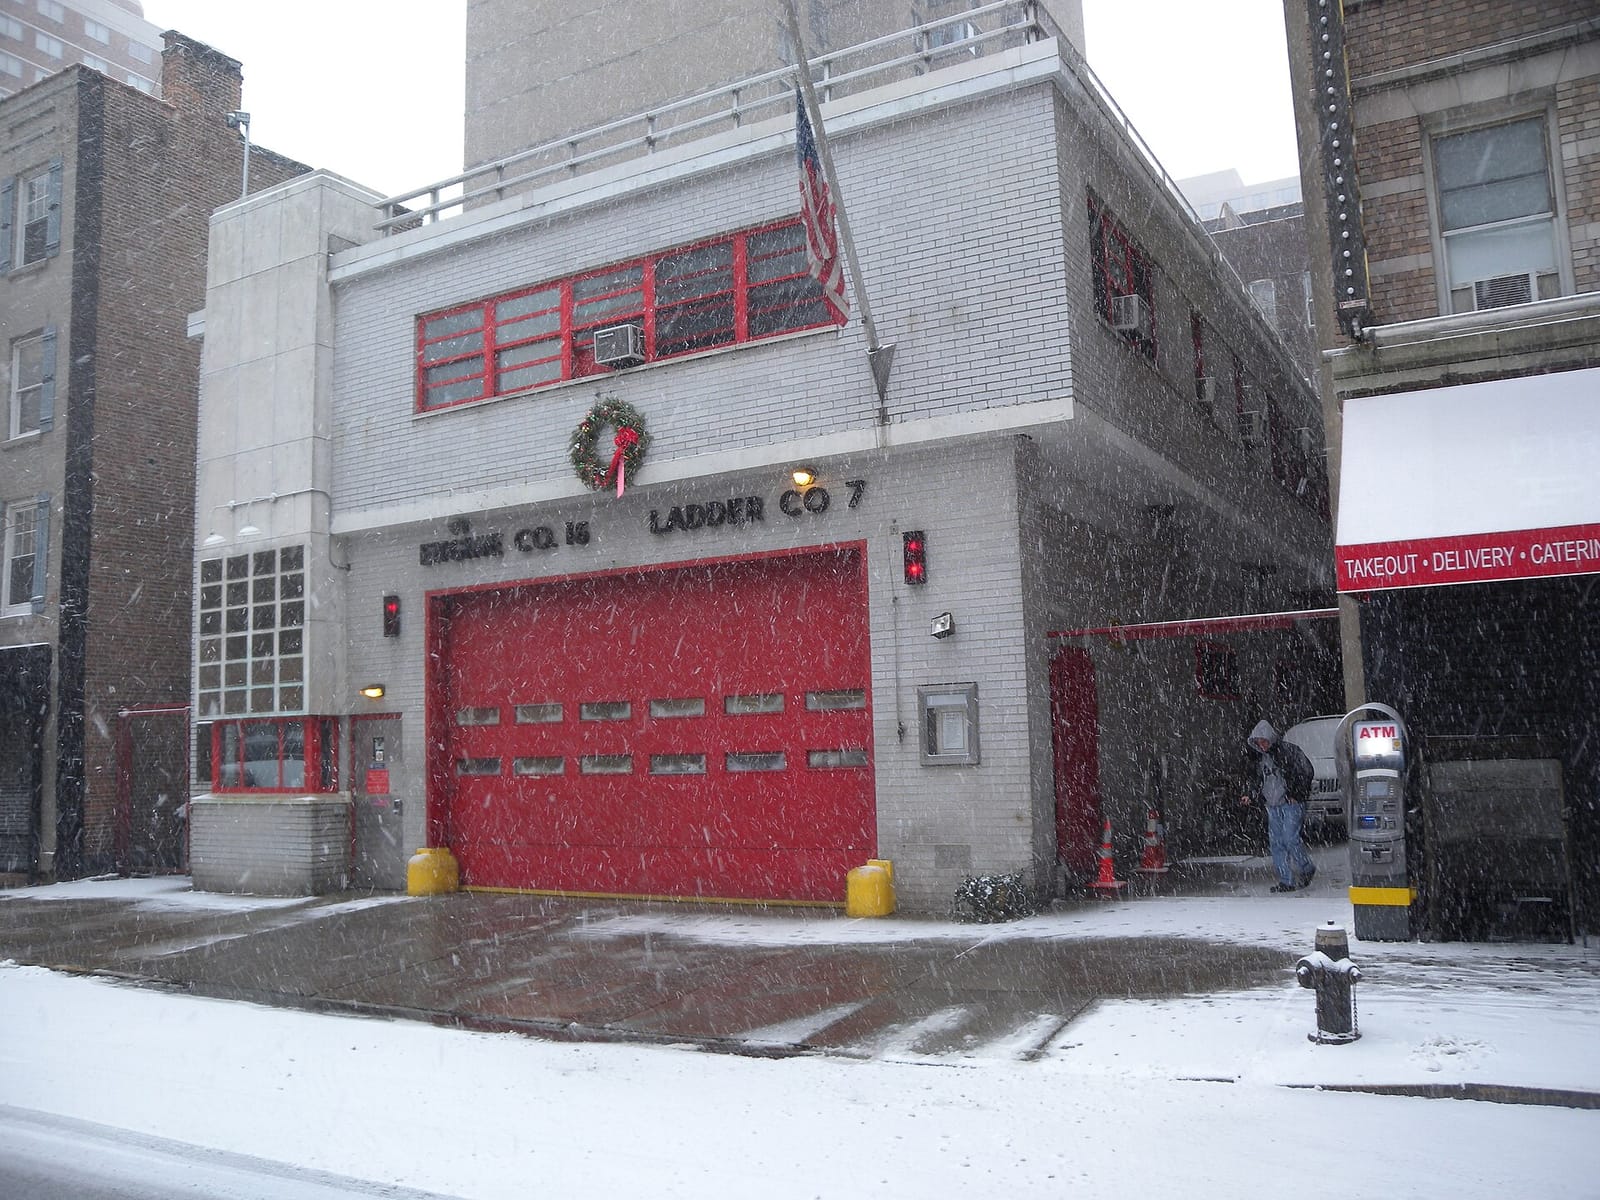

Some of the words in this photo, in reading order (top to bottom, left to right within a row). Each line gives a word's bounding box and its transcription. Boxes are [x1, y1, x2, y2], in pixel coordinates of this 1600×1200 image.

[649, 496, 764, 534] LADDER
[779, 486, 830, 516] CO
[845, 480, 866, 508] 7
[565, 520, 590, 545] 16
[1344, 554, 1418, 578] TAKEOUT
[1433, 546, 1515, 571] DELIVERY
[1360, 726, 1395, 738] ATM
